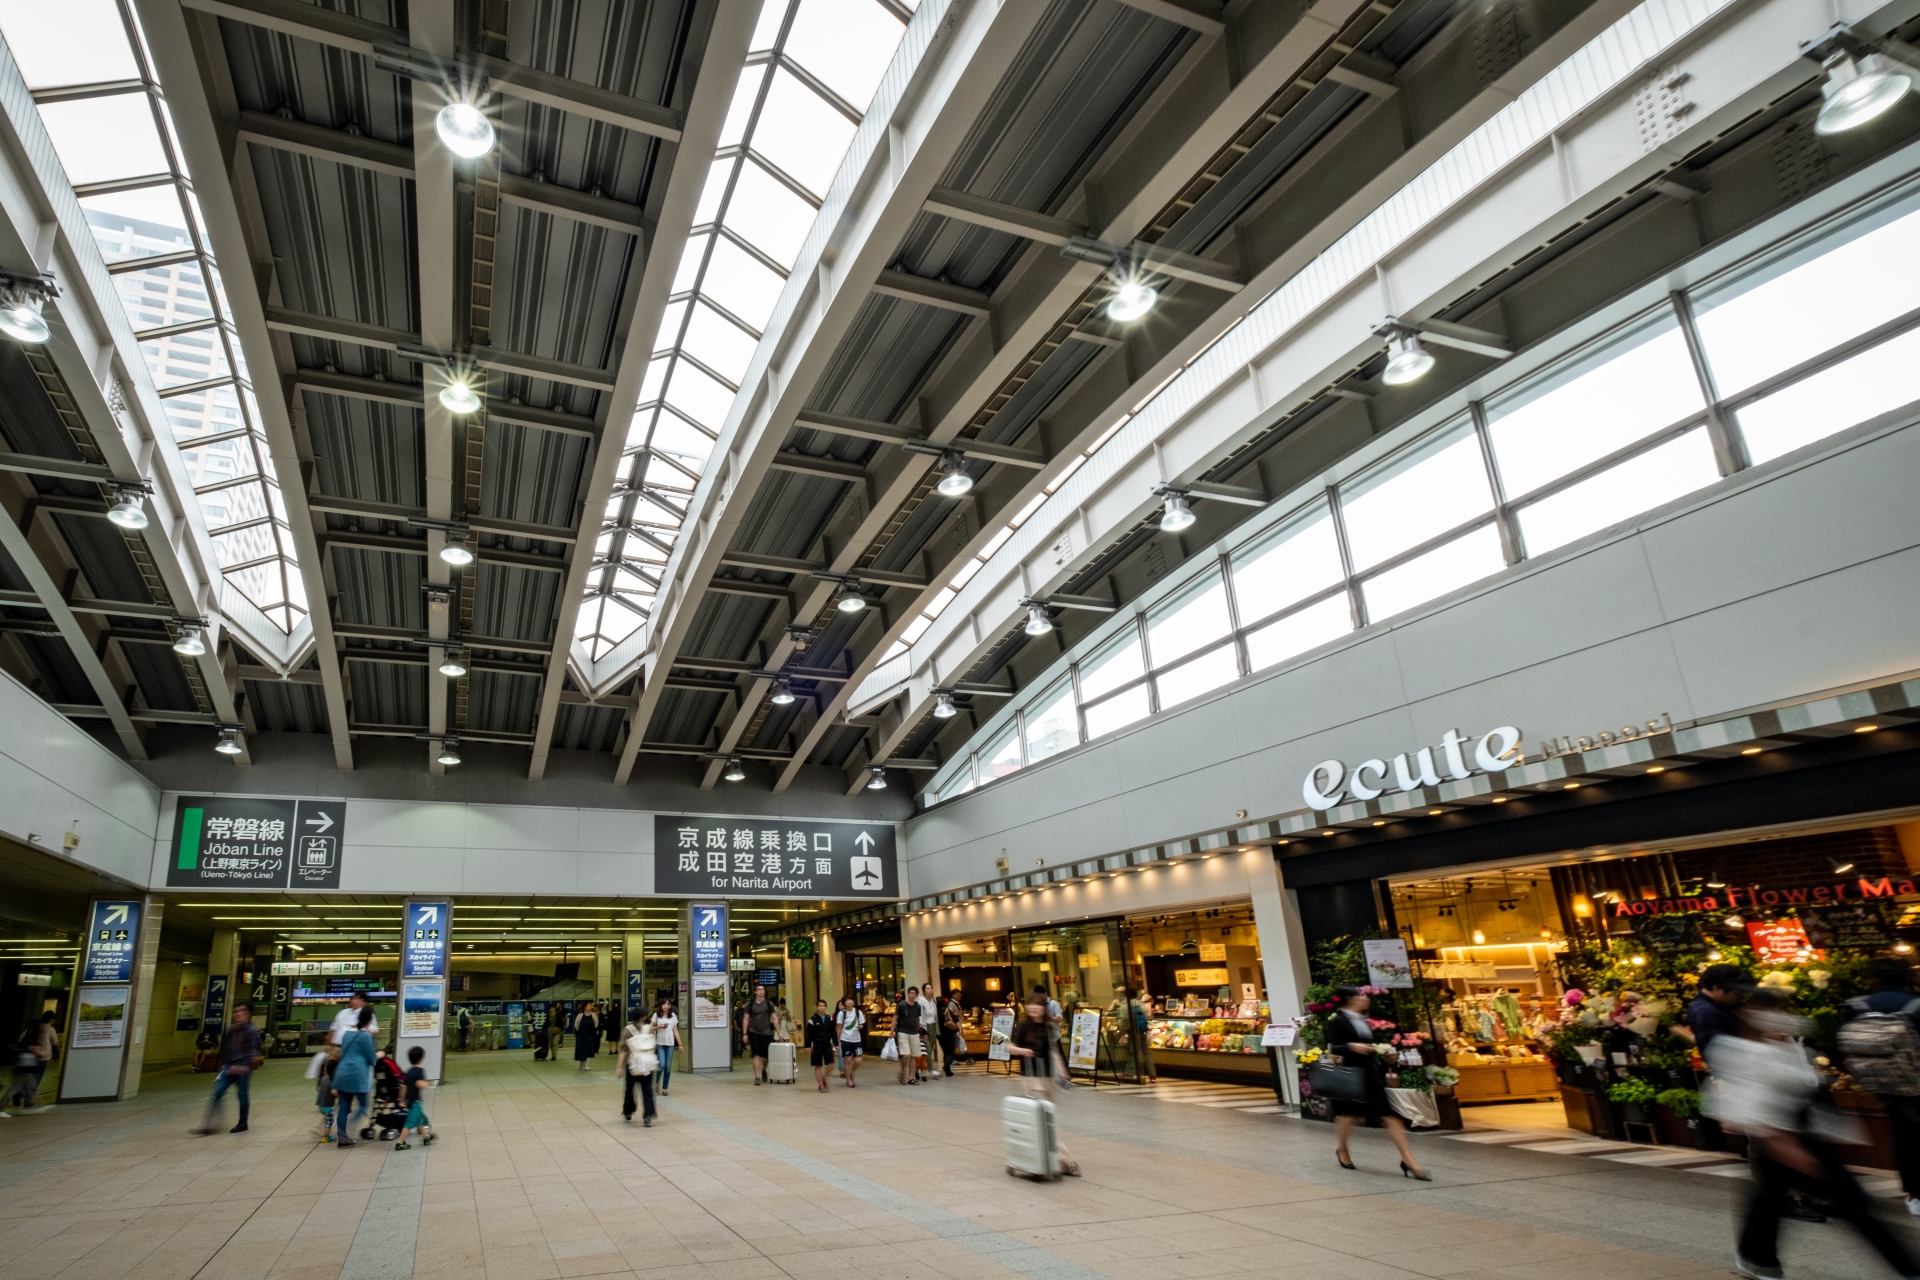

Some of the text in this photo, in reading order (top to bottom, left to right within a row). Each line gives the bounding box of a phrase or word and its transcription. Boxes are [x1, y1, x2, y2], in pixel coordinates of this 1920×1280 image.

[1302, 712, 1677, 811] ecute Nippori
[207, 817, 285, 842] 常磐線
[677, 826, 832, 852] 京成線乗換口
[203, 842, 284, 856] Jōban Line
[201, 857, 282, 871] (上野東京ライン)
[677, 850, 832, 875] 成田空港方面
[200, 871, 274, 879] (Ueno-Tōkyō Line)
[711, 875, 813, 891] for Narita Airport
[1615, 895, 1719, 917] Aoyama
[1725, 883, 1847, 908] Flower
[252, 984, 265, 1001] 4
[276, 986, 287, 1003] 3
[740, 981, 750, 995] 4
[478, 1003, 500, 1013] Airport
